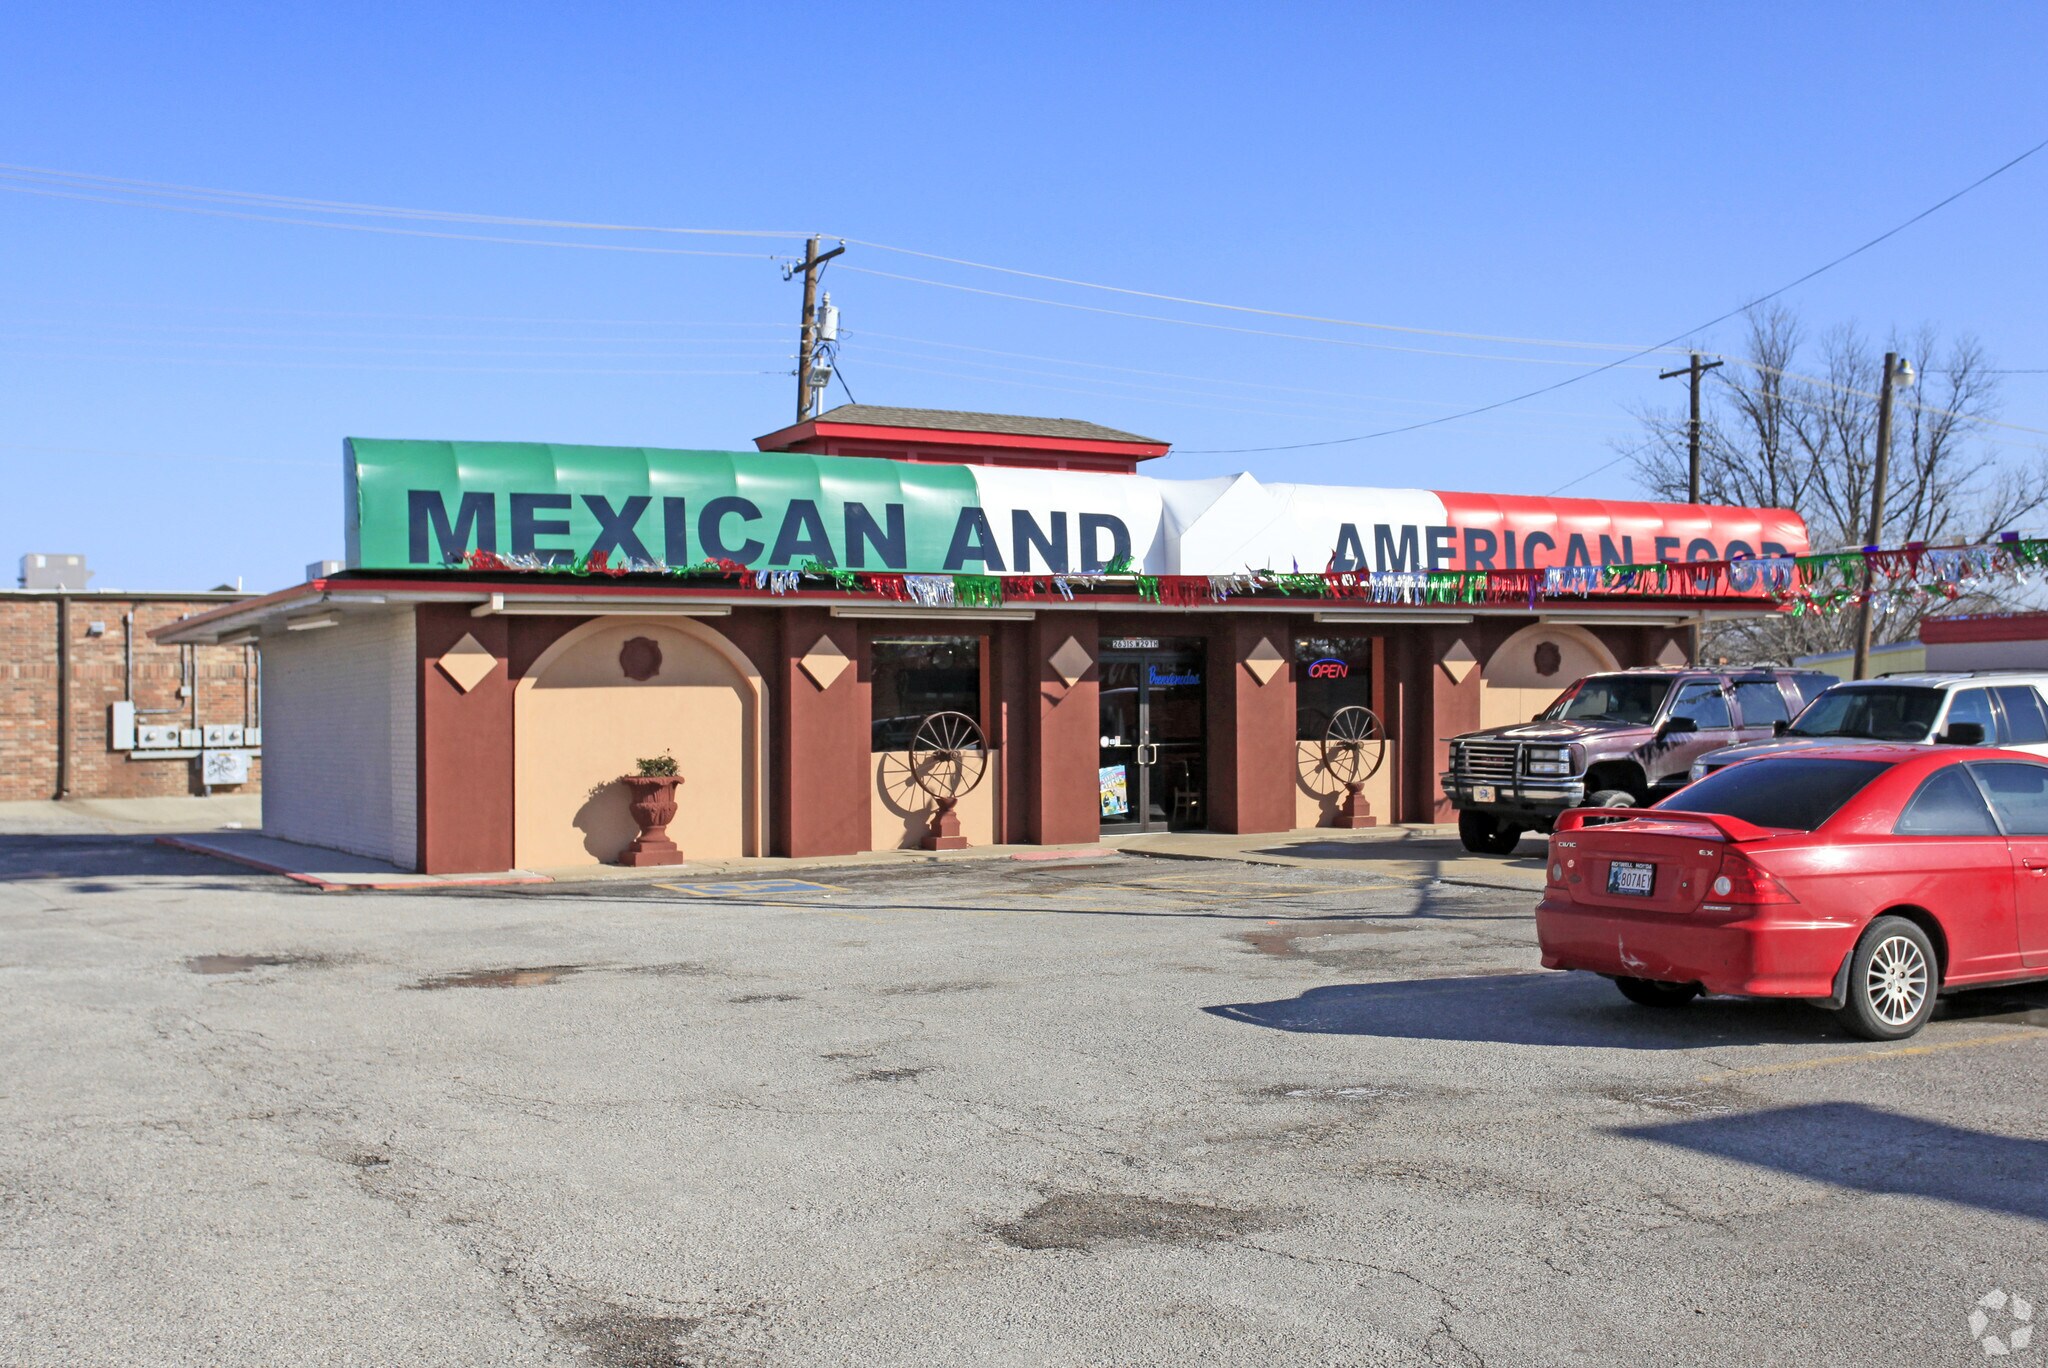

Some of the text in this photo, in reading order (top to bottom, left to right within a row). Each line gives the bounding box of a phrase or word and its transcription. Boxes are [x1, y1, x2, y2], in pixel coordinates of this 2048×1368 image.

[407, 489, 1792, 592] MEXICAN AND AMERICAN FOOD
[1311, 664, 1348, 678] OPEN
[1698, 849, 1714, 857] EX
[1620, 872, 1652, 889] 807AEY
